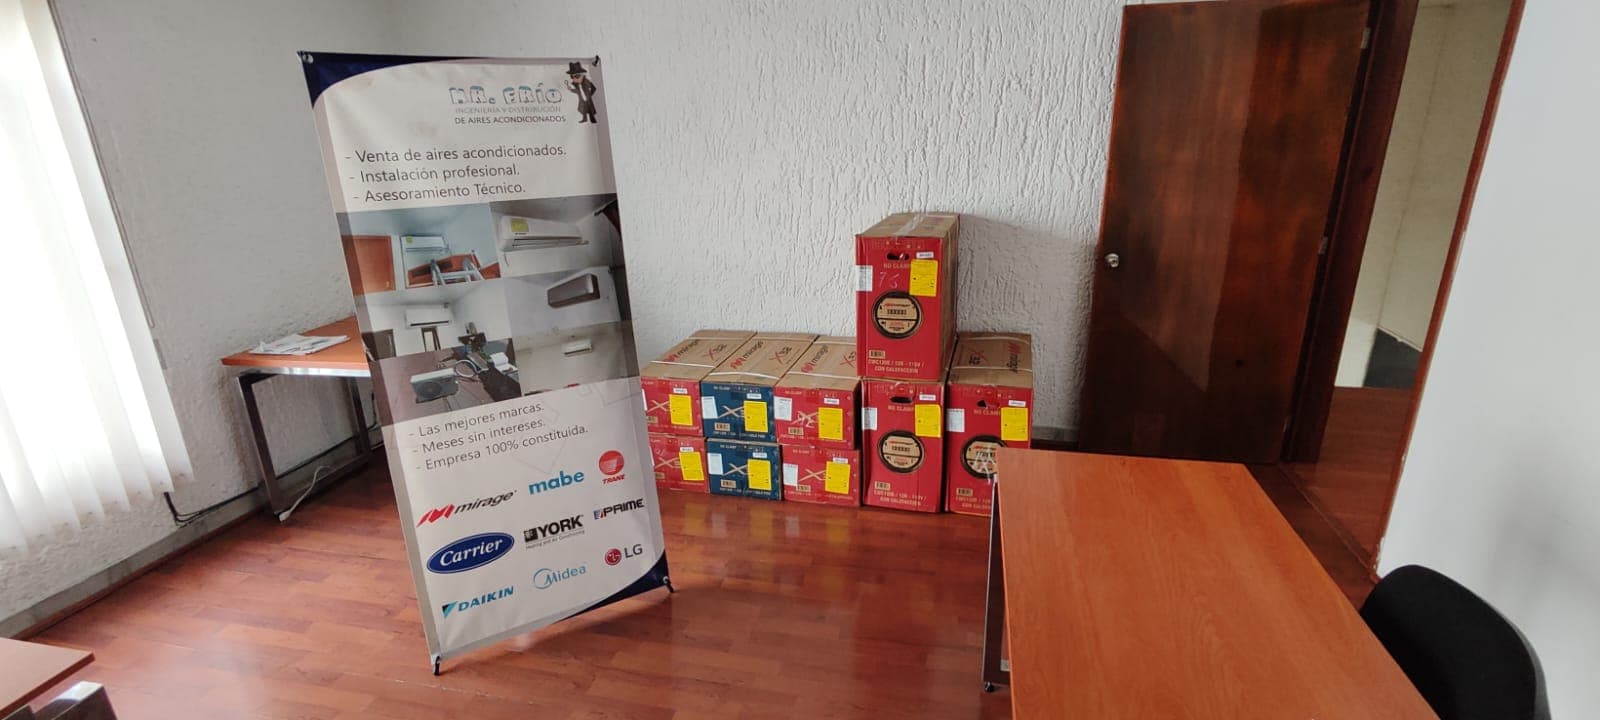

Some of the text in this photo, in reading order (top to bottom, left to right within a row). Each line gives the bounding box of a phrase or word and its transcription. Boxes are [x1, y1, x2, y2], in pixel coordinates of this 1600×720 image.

[454, 115, 567, 125] DE AIRES ACONDICIONADOS
[354, 149, 401, 163] Venta
[403, 148, 422, 162] de
[425, 147, 460, 161] aires
[462, 144, 567, 160] acondicionados.
[360, 167, 437, 183] Instalación
[443, 164, 520, 181] profesional.
[364, 186, 470, 202] Asesoramiento
[473, 182, 526, 197] Técnico.
[418, 424, 441, 437] Las
[444, 412, 496, 432] mejores
[499, 403, 545, 421] marcas.
[421, 436, 464, 454] Meses
[467, 430, 486, 443] sin
[489, 420, 546, 439] intereses.
[424, 451, 481, 471] Empresa
[486, 440, 519, 456] 100%
[522, 425, 589, 448] constituida.
[528, 470, 586, 495] mabe
[602, 474, 626, 485] TRANE
[453, 490, 515, 515] mirage
[602, 498, 645, 519] PRIME
[537, 514, 584, 538] YORK
[440, 538, 503, 566] Carrier
[624, 544, 643, 559] LG
[538, 565, 587, 587] Midea
[458, 585, 514, 612] DAIKIN
